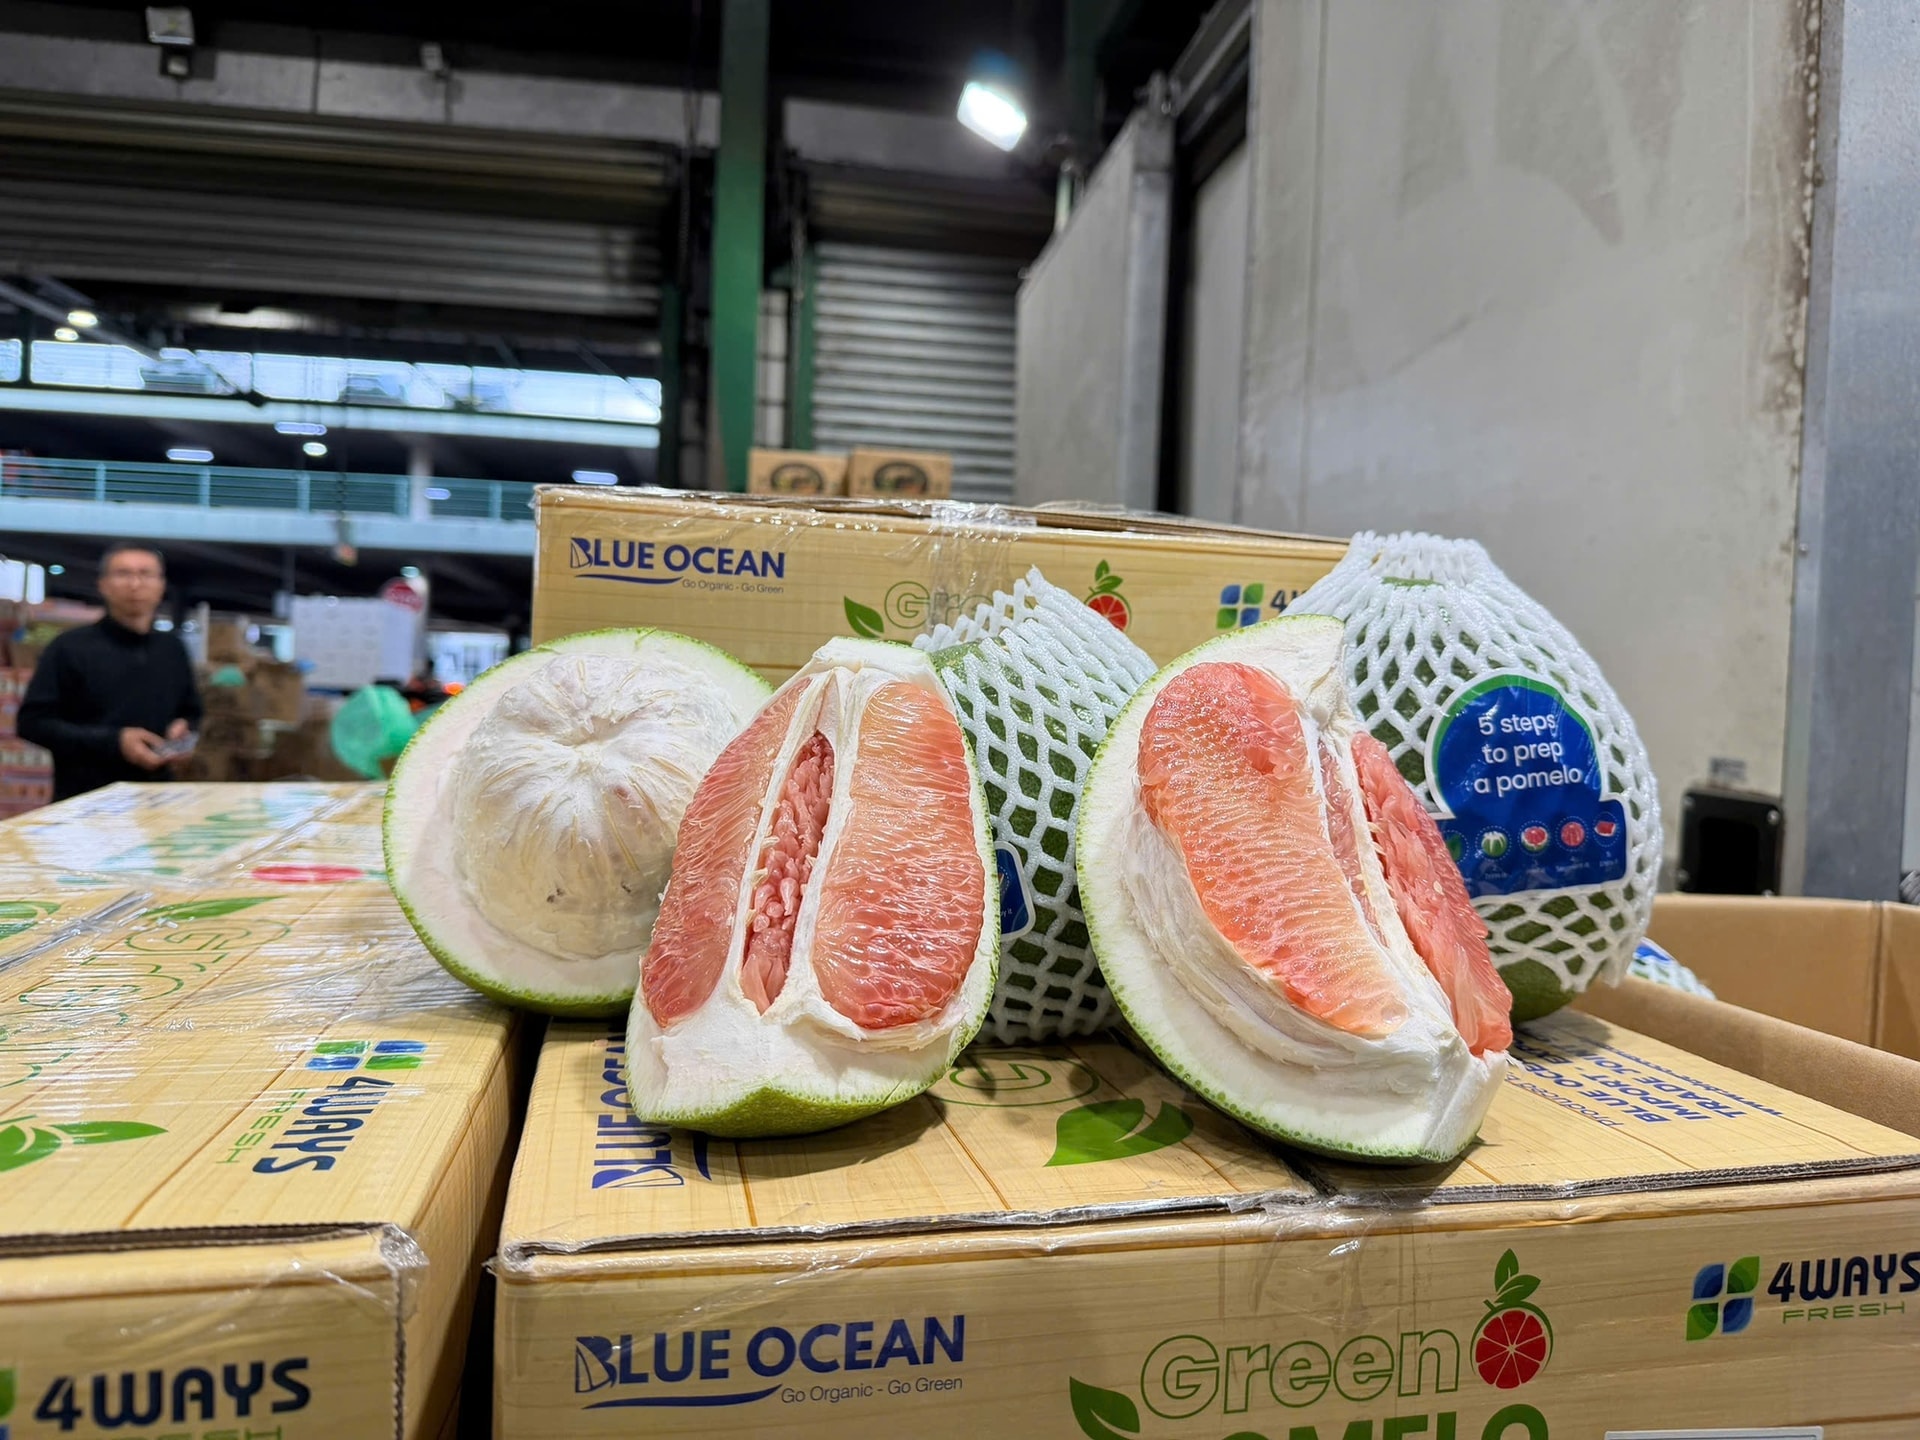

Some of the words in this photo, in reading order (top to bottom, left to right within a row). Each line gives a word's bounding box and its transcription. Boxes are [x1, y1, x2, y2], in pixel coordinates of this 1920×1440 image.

[570, 537, 655, 569] BLUE
[663, 544, 785, 578] OCEAN
[682, 578, 696, 588] Go
[699, 579, 734, 592] Organic
[741, 582, 755, 593] Go
[757, 584, 784, 594] Green
[1478, 716, 1495, 735] 5
[1500, 713, 1557, 736] steps
[1482, 743, 1507, 763] to
[1513, 740, 1563, 766] prep
[1474, 778, 1491, 794] a
[1496, 764, 1583, 798] pomelo
[1578, 1089, 1671, 1122] BLUE
[1580, 1072, 1711, 1120] IMPORT
[1632, 1076, 1748, 1118] TRADE
[216, 1088, 309, 1164] FRESH
[252, 1076, 396, 1174] 4WAYS
[1767, 1251, 1920, 1303] 4WAYS
[1783, 1302, 1905, 1324] FRESH
[575, 1328, 731, 1393] BLUE
[746, 1314, 965, 1377] OCEAN
[1141, 1328, 1461, 1419] Green
[33, 1357, 313, 1432] 4WAYS
[781, 1387, 806, 1404] Go
[809, 1382, 874, 1404] Organic
[887, 1379, 912, 1396] Go
[915, 1375, 963, 1393] Green
